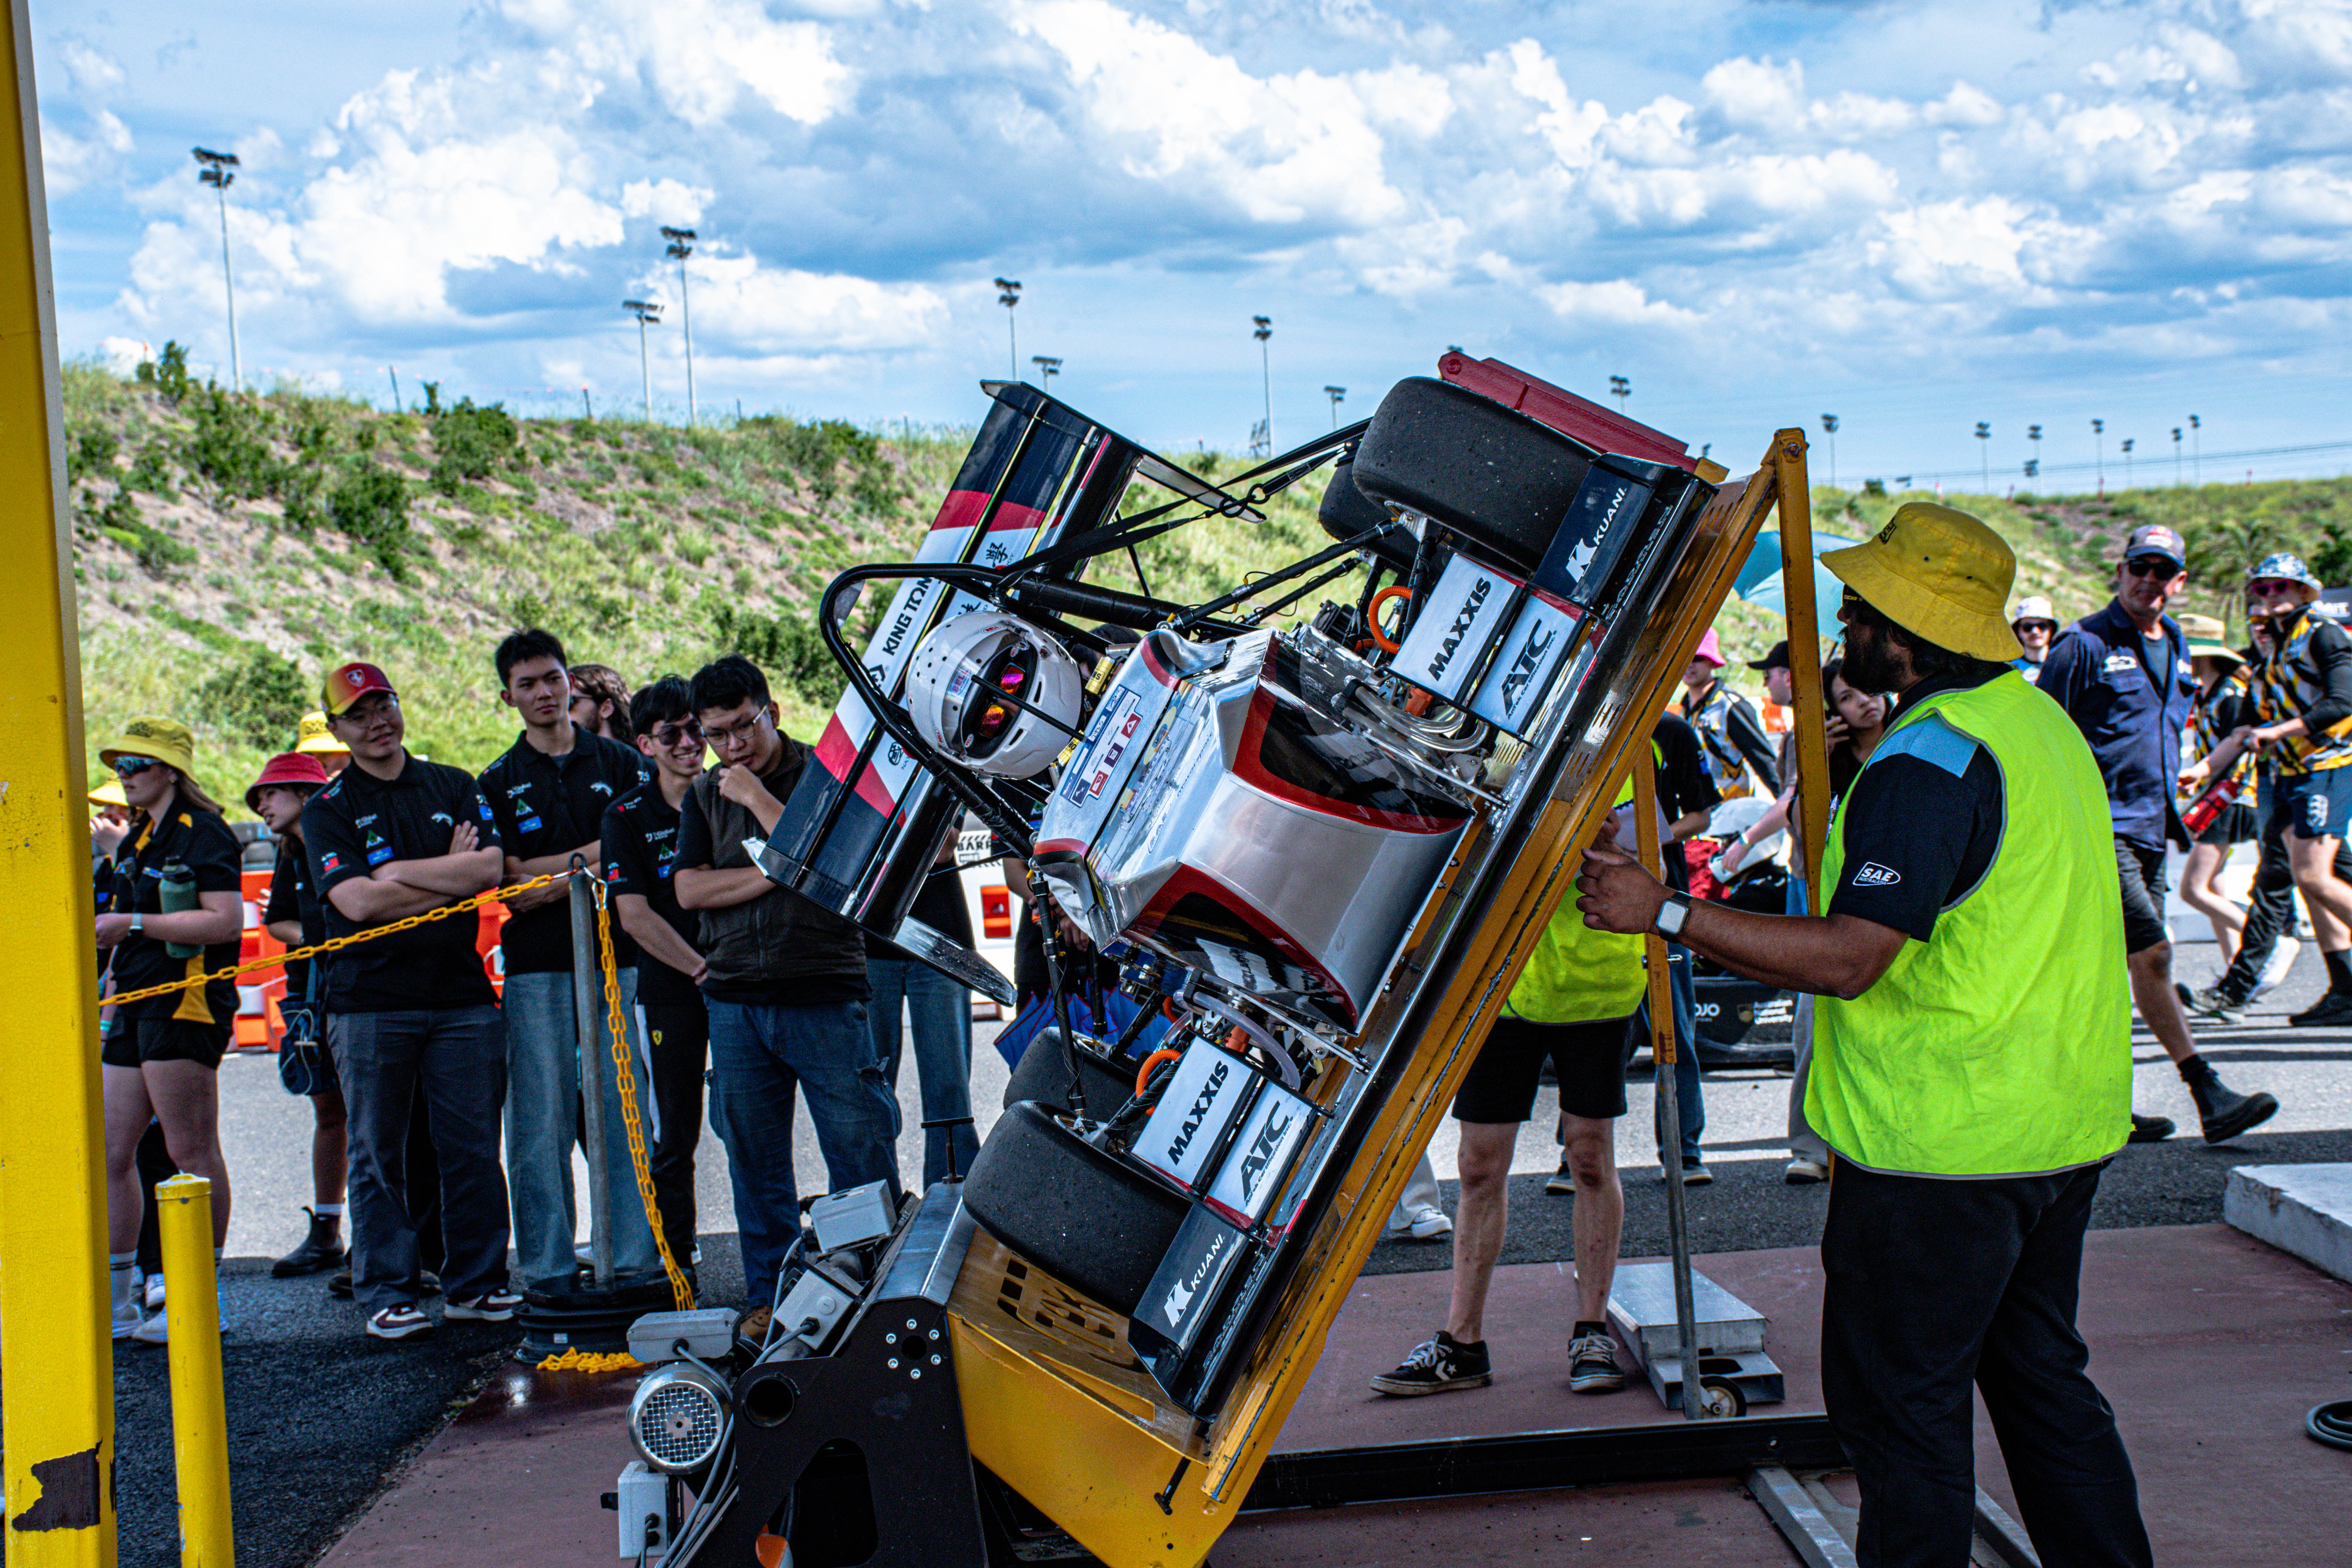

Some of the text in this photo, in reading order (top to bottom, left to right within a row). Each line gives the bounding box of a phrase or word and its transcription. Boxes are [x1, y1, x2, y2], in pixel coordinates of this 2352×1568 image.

[1593, 487, 1625, 546] KUANI
[882, 577, 933, 656] KING TON
[1428, 577, 1491, 681] MAXXIS
[952, 670, 969, 693] BELL
[1501, 618, 1552, 716] ATC
[1521, 649, 1548, 696] Certification
[1861, 868, 1894, 882] SAE
[1754, 1014, 1794, 1025] University
[1168, 1060, 1228, 1166] MAXXIS
[1241, 1100, 1289, 1201] ATC
[1258, 1135, 1284, 1181] Certification
[1190, 1233, 1223, 1291] KUANI
